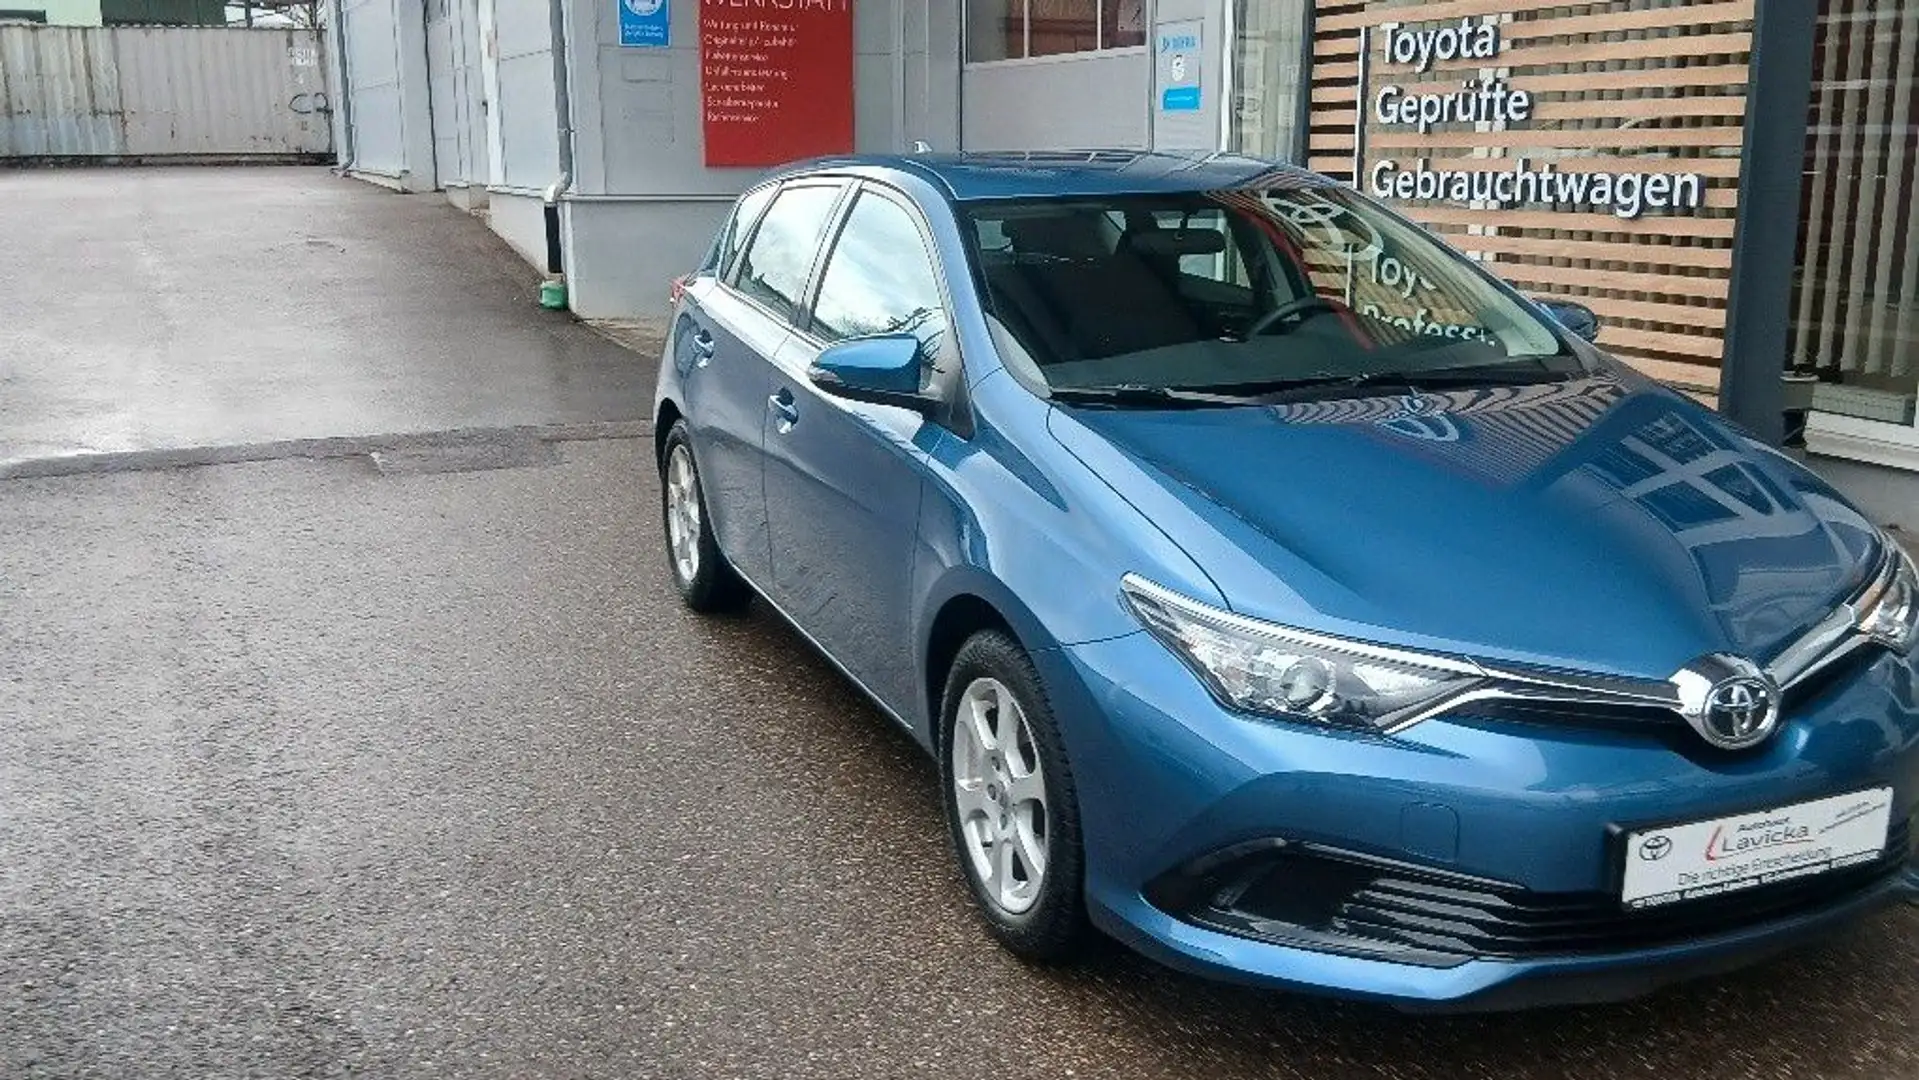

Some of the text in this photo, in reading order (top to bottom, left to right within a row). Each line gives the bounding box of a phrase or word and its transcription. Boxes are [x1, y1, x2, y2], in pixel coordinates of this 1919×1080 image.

[1380, 17, 1496, 73] Toyota
[1375, 79, 1530, 133] Geprüfte
[1371, 159, 1700, 219] Gebrauchtwagen
[1722, 826, 1810, 851] Lavicka
[1678, 872, 1700, 886] Die
